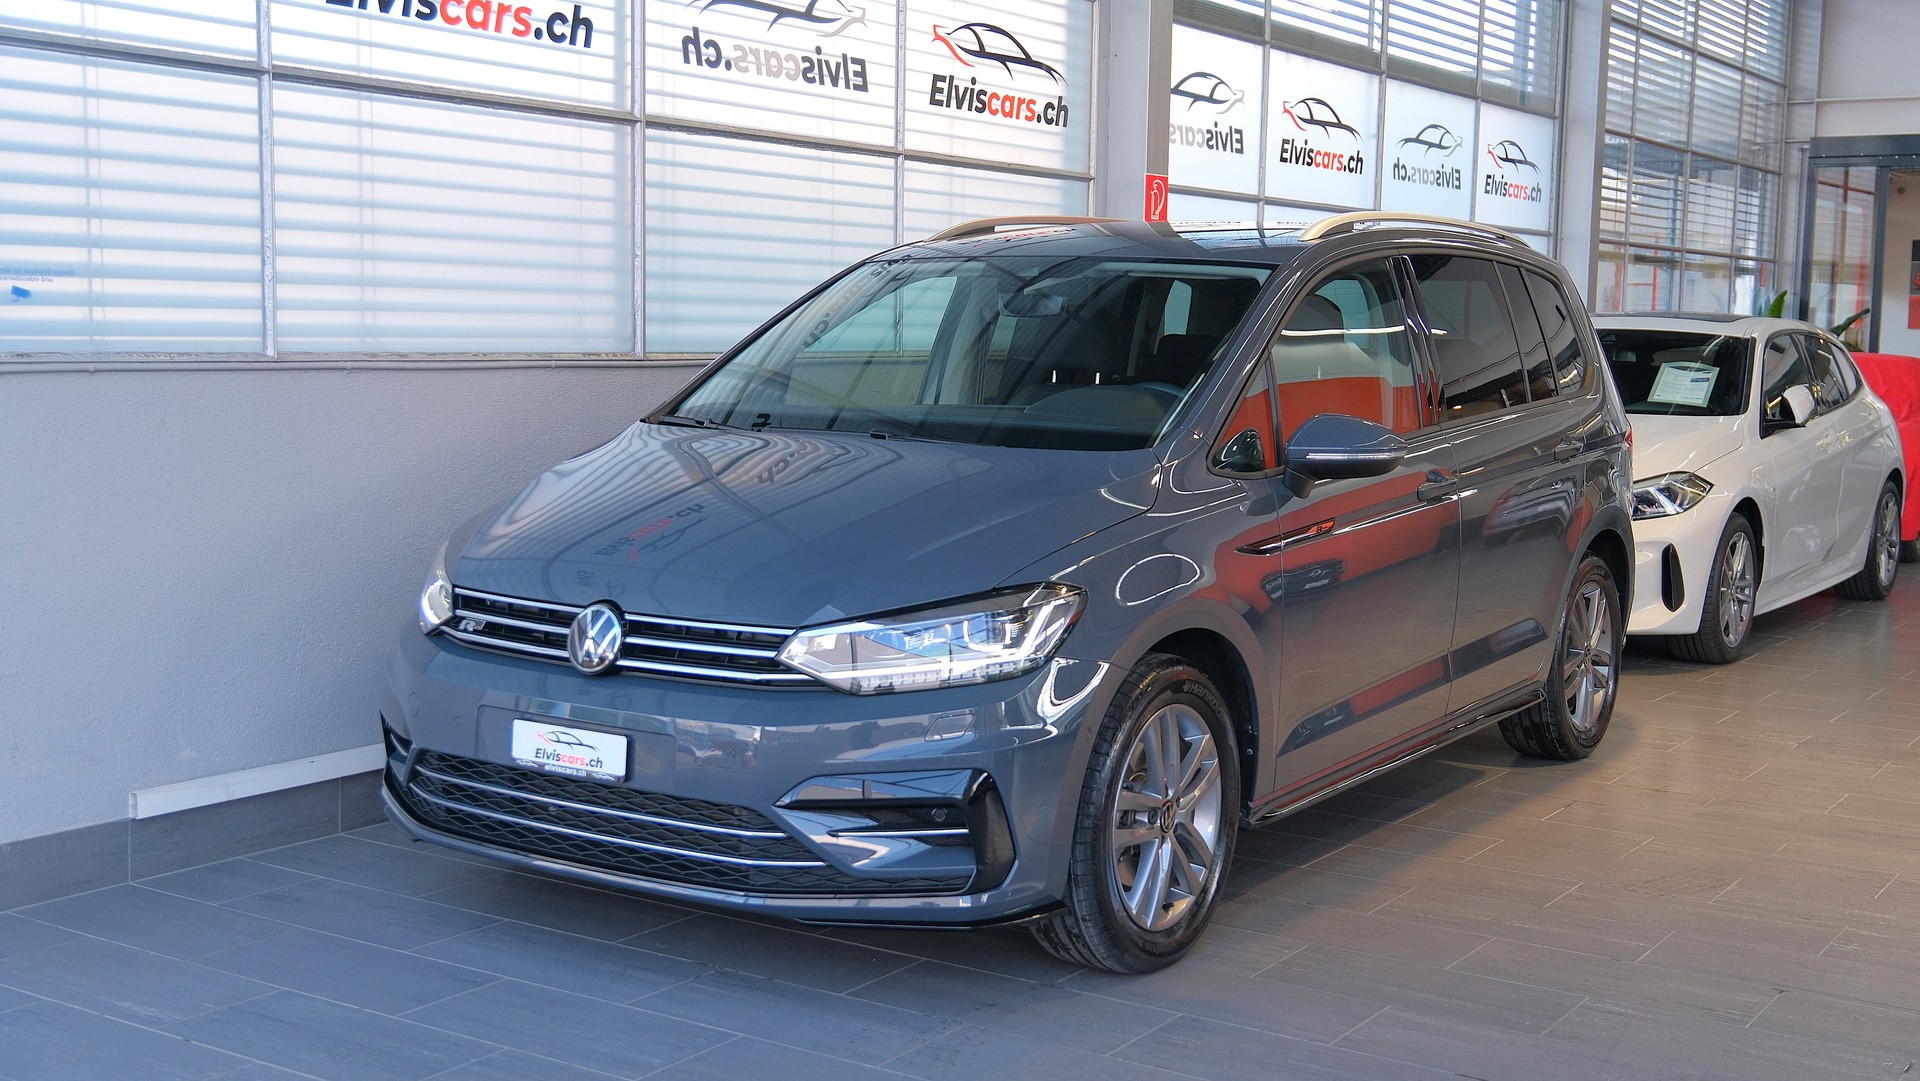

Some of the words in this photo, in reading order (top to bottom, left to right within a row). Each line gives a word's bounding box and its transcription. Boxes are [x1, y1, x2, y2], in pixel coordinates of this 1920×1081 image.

[325, 0, 594, 48] vscars.ch
[929, 73, 1070, 128] Elviscars.ch
[1279, 138, 1364, 175] Elviscars.ch
[1484, 174, 1543, 203] Elviscars.ch
[535, 747, 604, 769] Elviscars.ch
[544, 763, 587, 777] elviscars.ch
